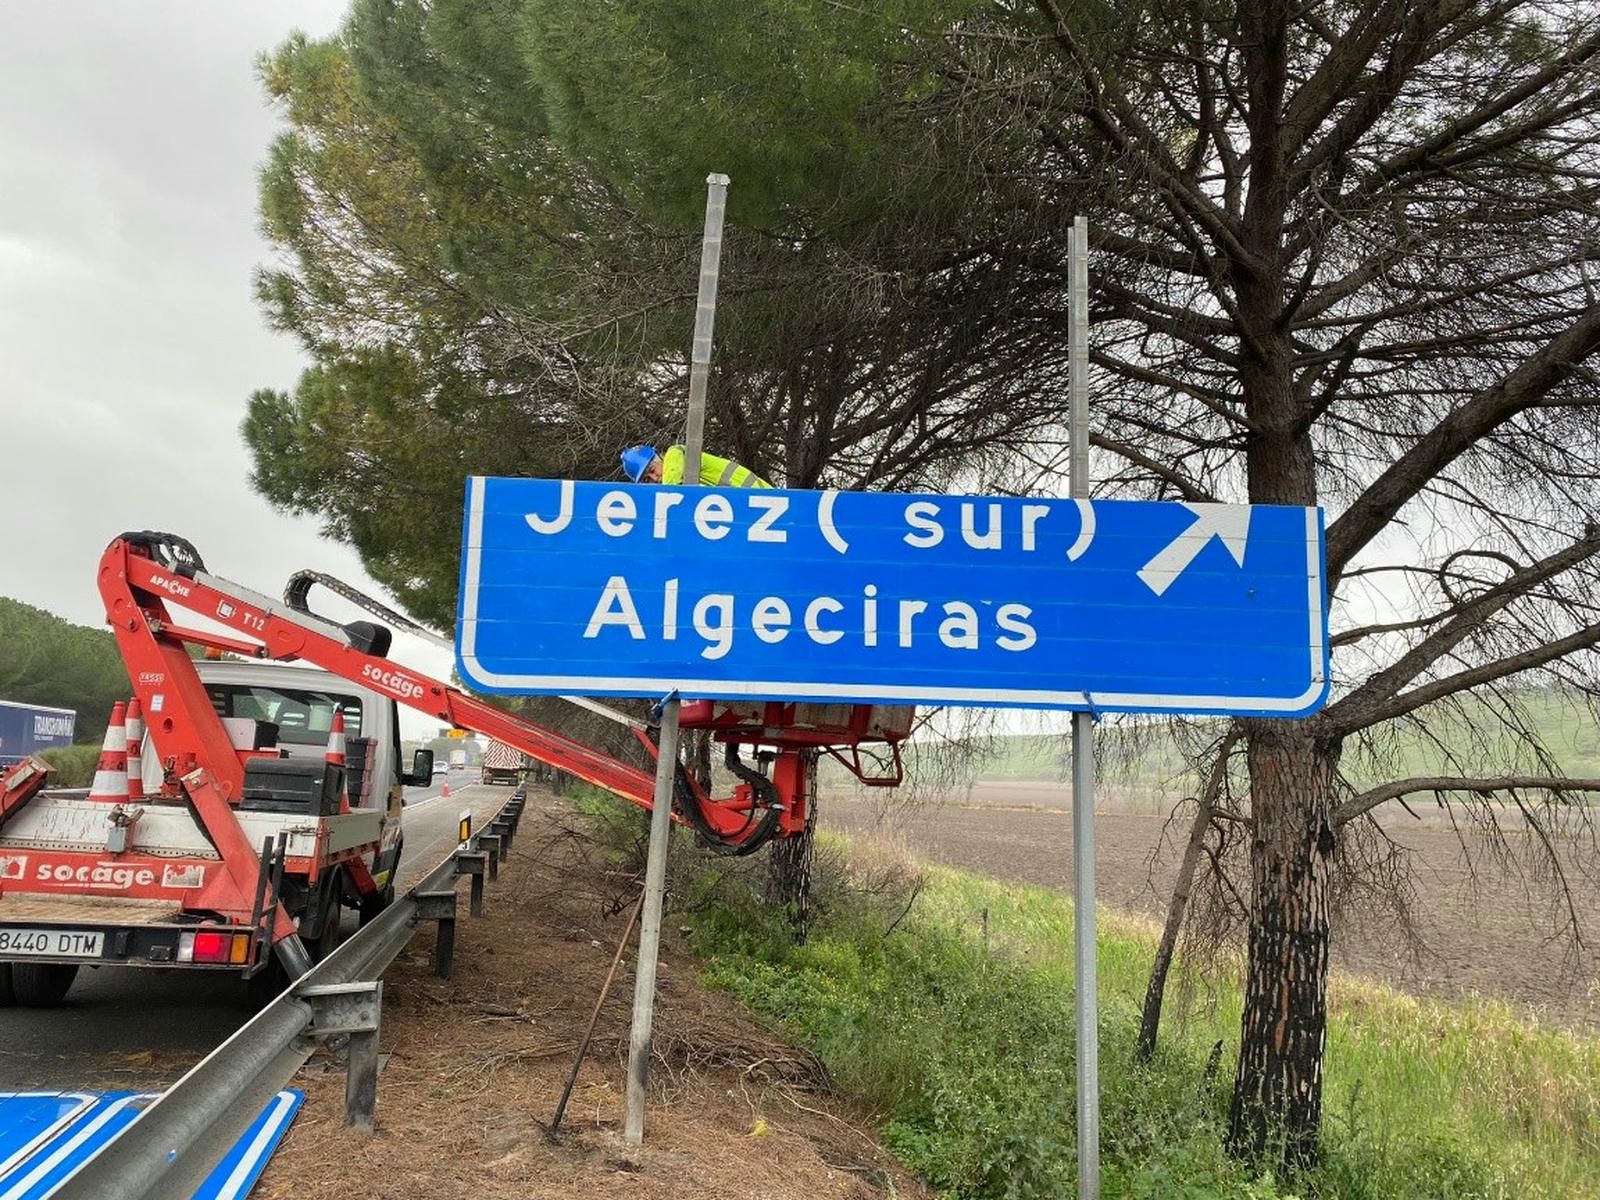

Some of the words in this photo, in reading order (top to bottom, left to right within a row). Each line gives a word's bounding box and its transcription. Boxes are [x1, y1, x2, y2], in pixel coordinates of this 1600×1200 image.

[150, 575, 190, 597] APACHE
[243, 612, 265, 631] T12
[583, 576, 1037, 660] Algeciras
[362, 664, 424, 698] socage
[36, 864, 154, 889] socage
[0, 932, 48, 952] 8440
[58, 934, 97, 954] DTM
